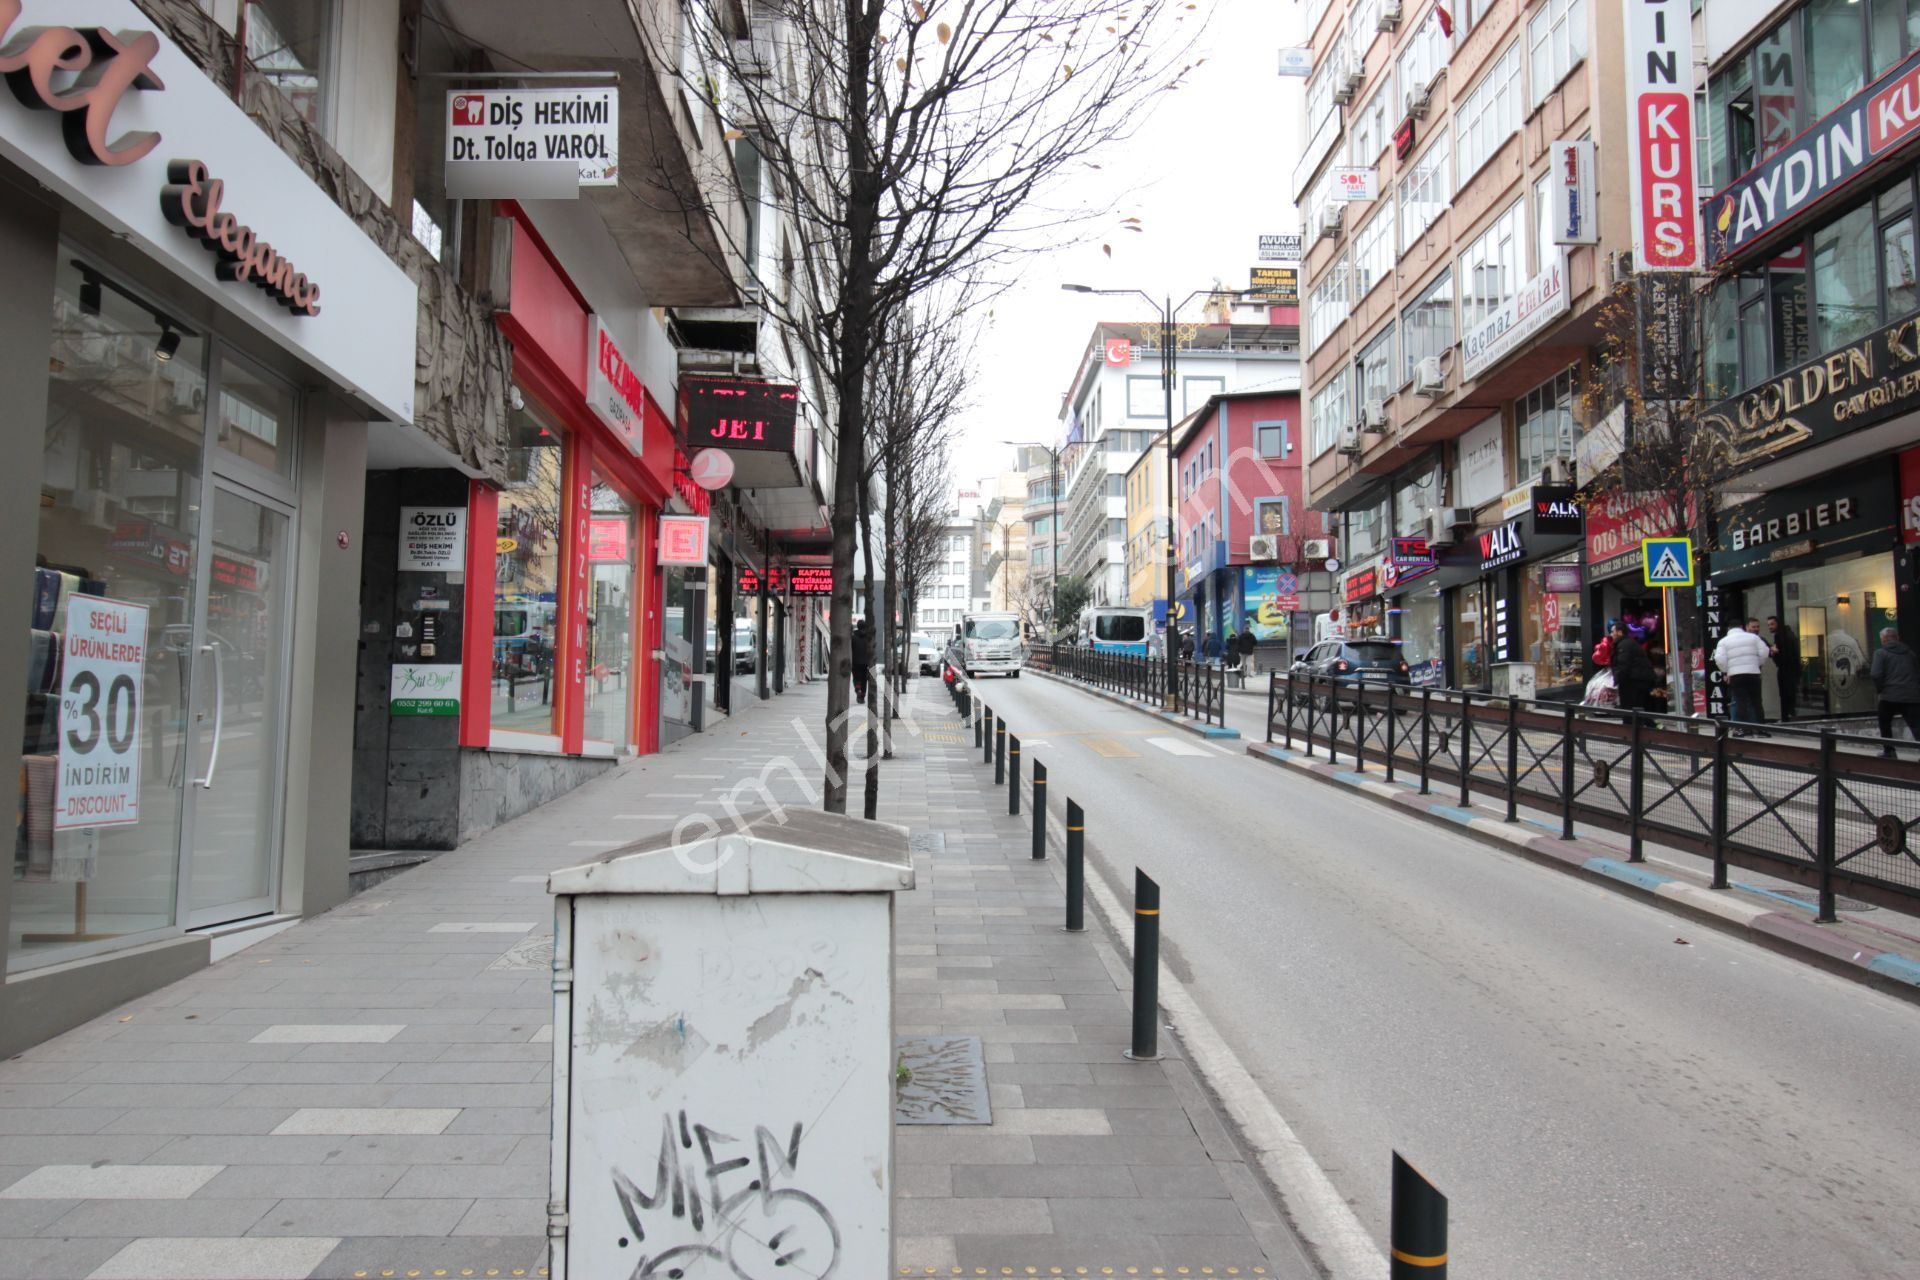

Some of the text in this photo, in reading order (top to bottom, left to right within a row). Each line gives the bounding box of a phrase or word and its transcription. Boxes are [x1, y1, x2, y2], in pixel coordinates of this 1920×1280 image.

[490, 94, 608, 130] DİŞ HEKİMİ
[453, 133, 609, 161] Dt. Tolga VAROL
[1648, 104, 1684, 257] KURS
[1735, 109, 1862, 244] AYDIN
[162, 159, 321, 317] Elegance
[1261, 236, 1299, 244] AVUKAT
[1464, 265, 1560, 360] Kaçmaz Emlak
[598, 329, 644, 421] ECZANE
[1739, 339, 1874, 430] GOLDEN
[414, 512, 456, 526] ÖZLÜ
[1538, 502, 1578, 515] WALK
[1733, 498, 1851, 551] BARBIER
[1398, 541, 1431, 555] TS
[1480, 521, 1519, 560] WALK
[1593, 529, 1617, 556] OTO
[1481, 550, 1521, 570] COLLECTION
[575, 484, 588, 683] ECZANE
[89, 609, 127, 635] SEÇİLİ
[69, 634, 141, 664] ÜRÜNLERDE
[1710, 671, 1724, 714] CAR
[65, 763, 130, 787] İNDİRİM
[67, 794, 127, 816] DISCOUNT
